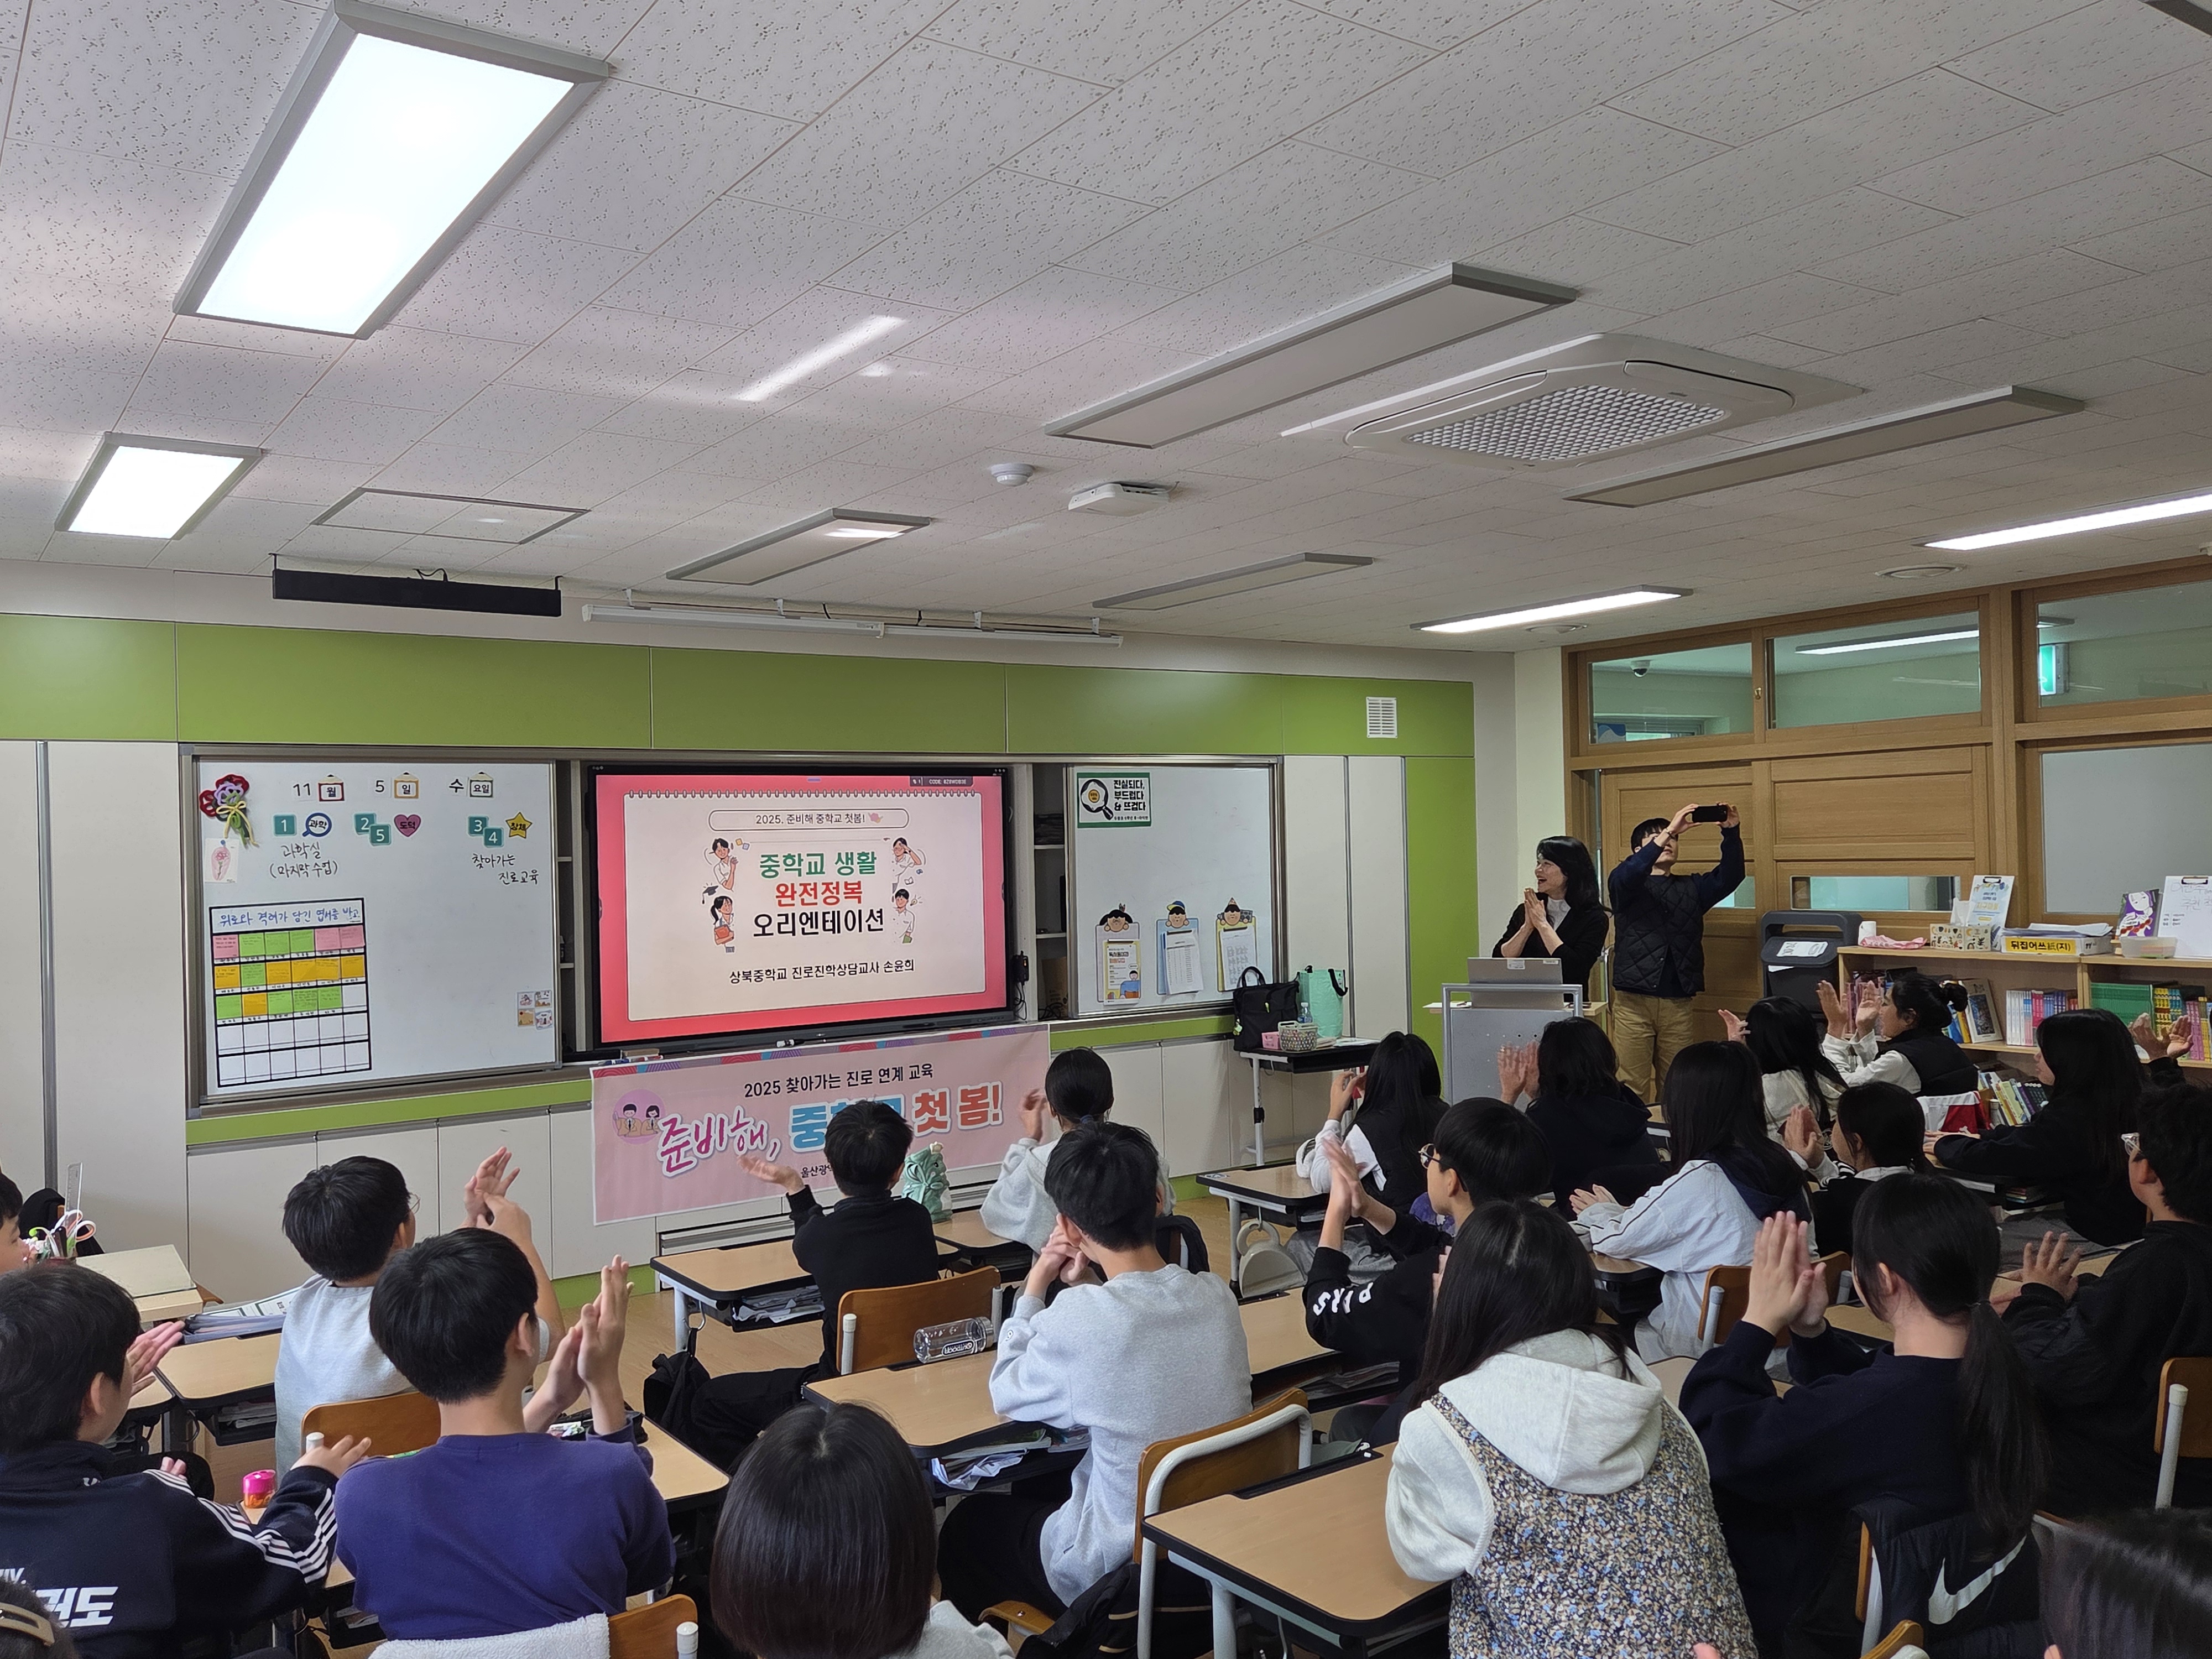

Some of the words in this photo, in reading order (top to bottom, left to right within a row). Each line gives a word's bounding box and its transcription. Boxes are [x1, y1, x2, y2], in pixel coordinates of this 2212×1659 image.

[293, 783, 311, 797] 11
[326, 786, 336, 797] 월
[375, 780, 385, 792] 5
[401, 784, 411, 795] 일
[448, 779, 465, 793] 수
[473, 784, 489, 794] 요일
[1113, 779, 1145, 790] 진실되다,
[1114, 791, 1144, 800] 부드럽다
[1114, 801, 1122, 811] &
[1123, 801, 1146, 811] 뜨겁다
[280, 819, 286, 832] 1
[309, 820, 327, 830] 과학
[360, 817, 369, 830] 2
[399, 821, 416, 830] 도덕
[755, 815, 784, 824] 2025.
[786, 813, 813, 824] 준비해
[816, 813, 842, 824] 중학교
[844, 813, 865, 824] 첫봄!
[474, 820, 483, 832] 3
[510, 822, 526, 831] 창체
[376, 829, 385, 842] 5
[488, 831, 498, 844] 4
[280, 841, 321, 859] 과학실
[472, 853, 516, 869] 찾아가는
[760, 853, 826, 878] 중학교
[834, 851, 877, 876] 생활
[270, 862, 310, 879] (마지막
[311, 860, 338, 878] 수업)
[775, 880, 863, 907] 완전정복
[220, 911, 253, 927] 위로와
[292, 910, 311, 922] 담긴
[753, 908, 884, 937] 오리엔테이션
[729, 968, 787, 984] 상북중학교
[791, 961, 880, 980] 진로진학상담교사
[883, 959, 914, 973] 손윤희
[744, 1080, 781, 1098] 2025
[785, 1073, 841, 1094] 찾아가는
[846, 1070, 873, 1087] 진로
[878, 1066, 904, 1084] 연계
[909, 1063, 933, 1079] 교육
[660, 1109, 778, 1173] 준비해,
[914, 1090, 948, 1134] 첫
[959, 1084, 1000, 1126] 봄!
[33, 1586, 119, 1629] 권도
